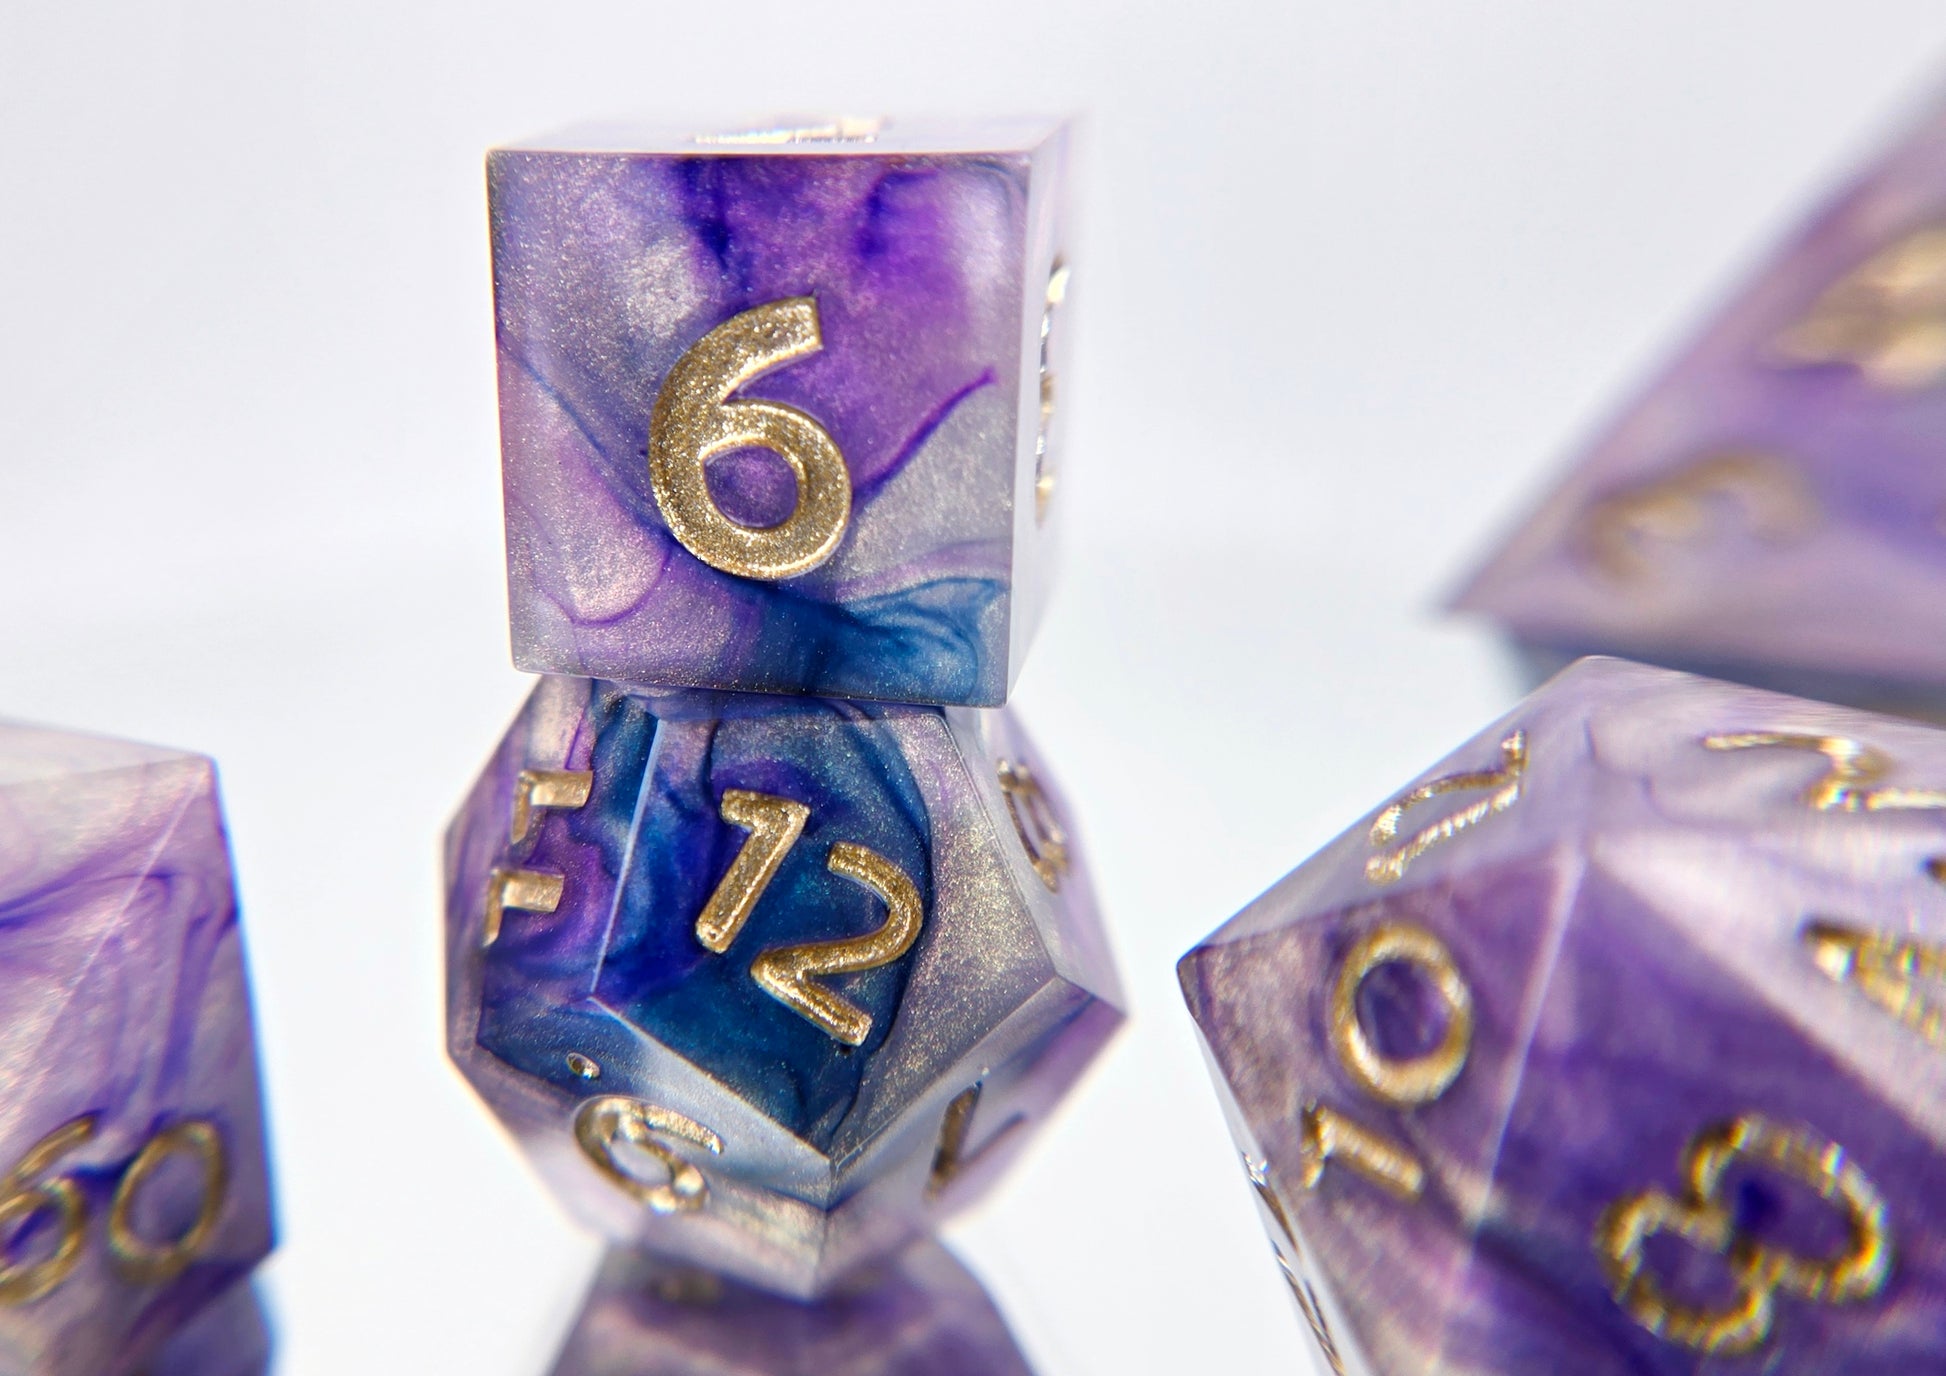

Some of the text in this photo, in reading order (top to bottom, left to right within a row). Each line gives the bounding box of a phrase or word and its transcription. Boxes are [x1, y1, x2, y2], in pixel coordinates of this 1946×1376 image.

[649, 296, 852, 582] 6
[696, 787, 924, 1048] 12
[1301, 920, 1475, 1202] 10
[1596, 1112, 1896, 1358] 8
